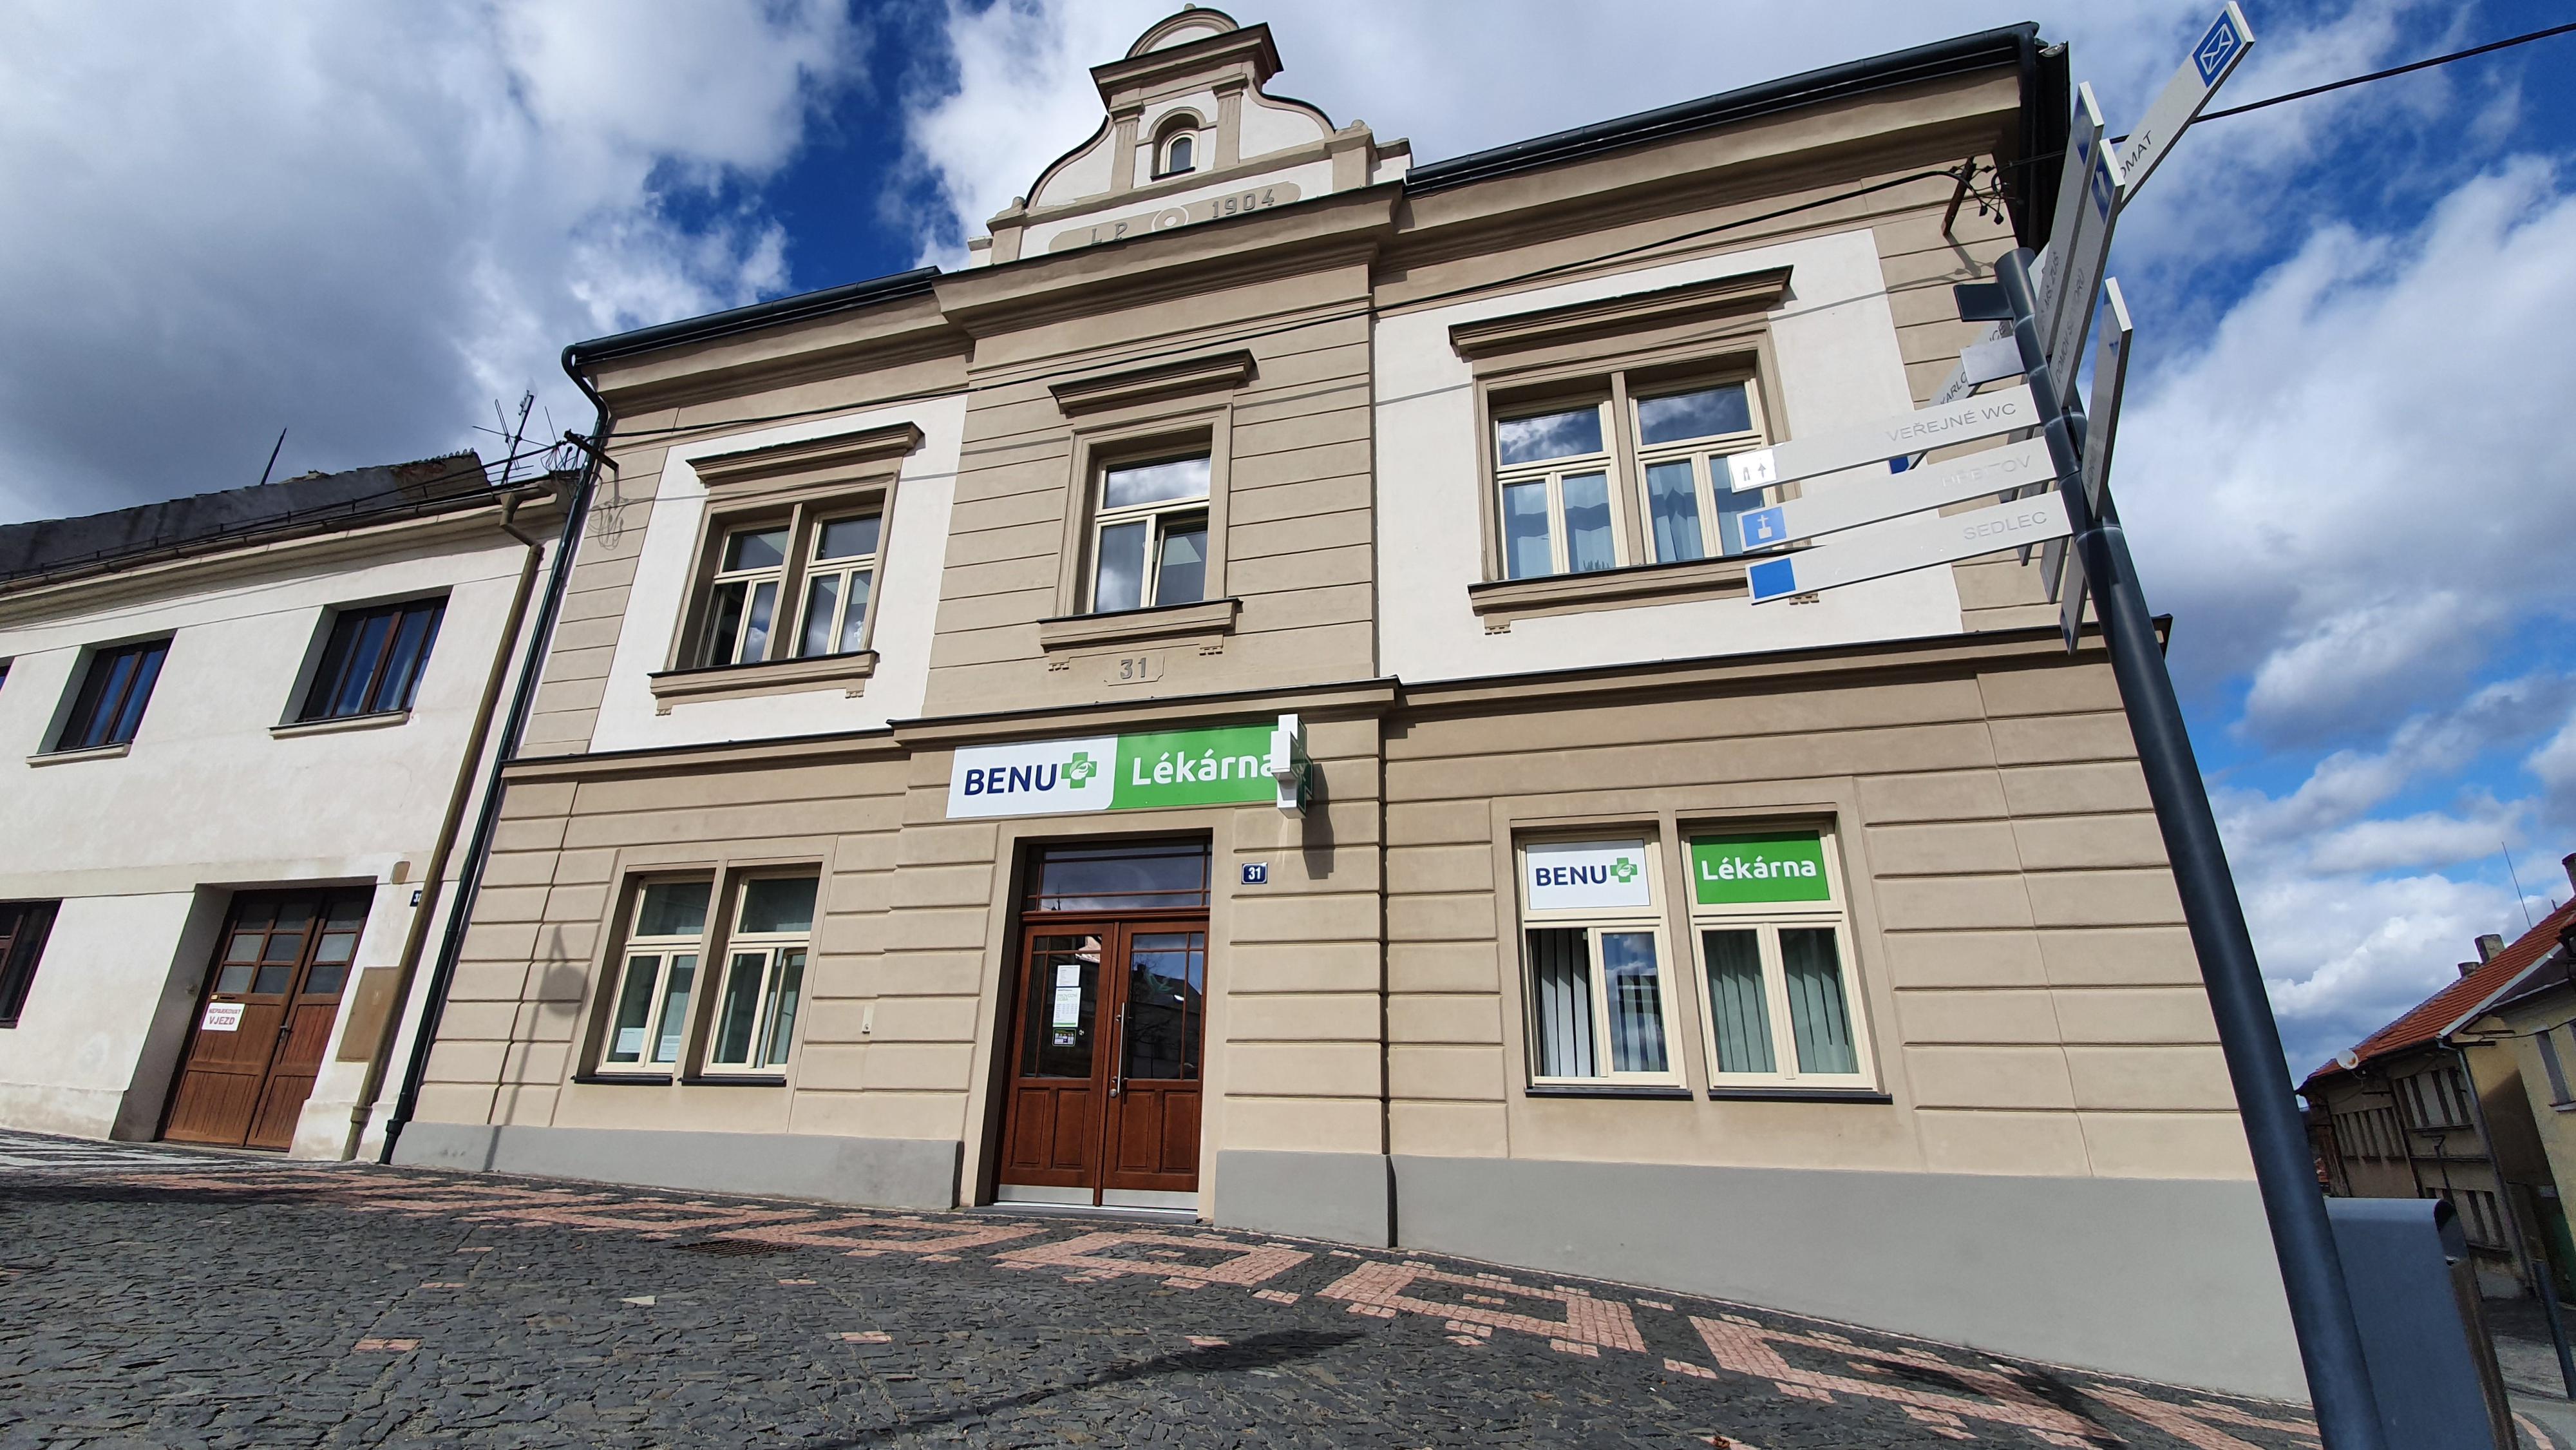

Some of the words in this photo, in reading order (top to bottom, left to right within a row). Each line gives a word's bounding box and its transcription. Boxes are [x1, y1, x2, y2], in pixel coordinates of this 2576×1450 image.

[1211, 189, 1275, 218] 1904
[1886, 410, 1977, 442] VEŘEJNÉ
[1981, 403, 2016, 420] WC
[1964, 511, 2047, 540] SEDLEC
[1120, 657, 1146, 680] 31
[964, 763, 1057, 796] BENU
[1248, 866, 1261, 880] 31
[1536, 865, 1607, 886] BENU
[1701, 855, 1817, 881] Lékárna
[209, 1016, 236, 1025] VJEZD
